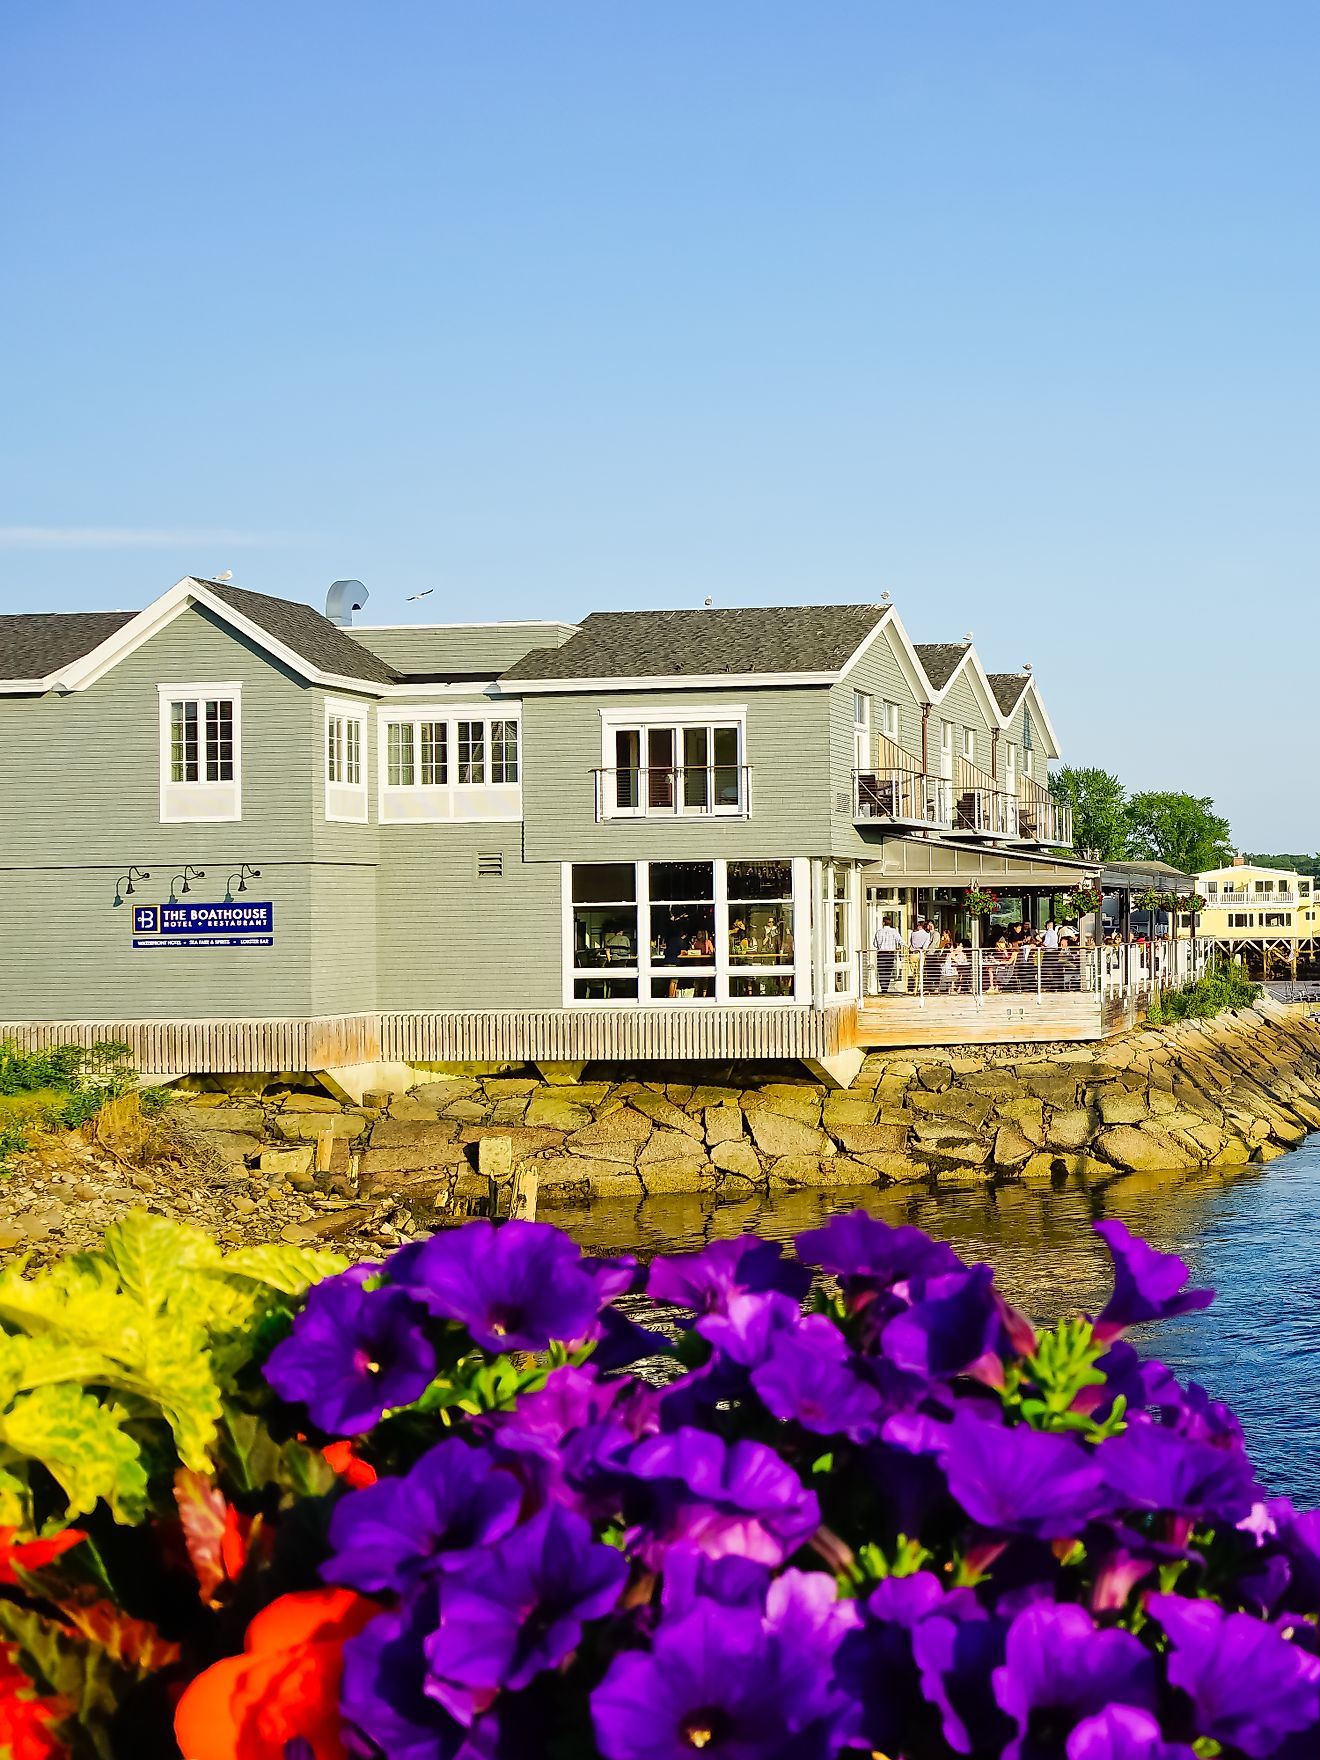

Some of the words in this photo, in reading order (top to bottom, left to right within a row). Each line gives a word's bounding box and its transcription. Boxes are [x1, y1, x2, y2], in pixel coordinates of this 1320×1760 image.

[163, 910, 187, 921] THE
[190, 908, 268, 921] BOATHOUSE
[163, 920, 193, 928] HOTEL
[207, 919, 268, 927] RESTAURANT
